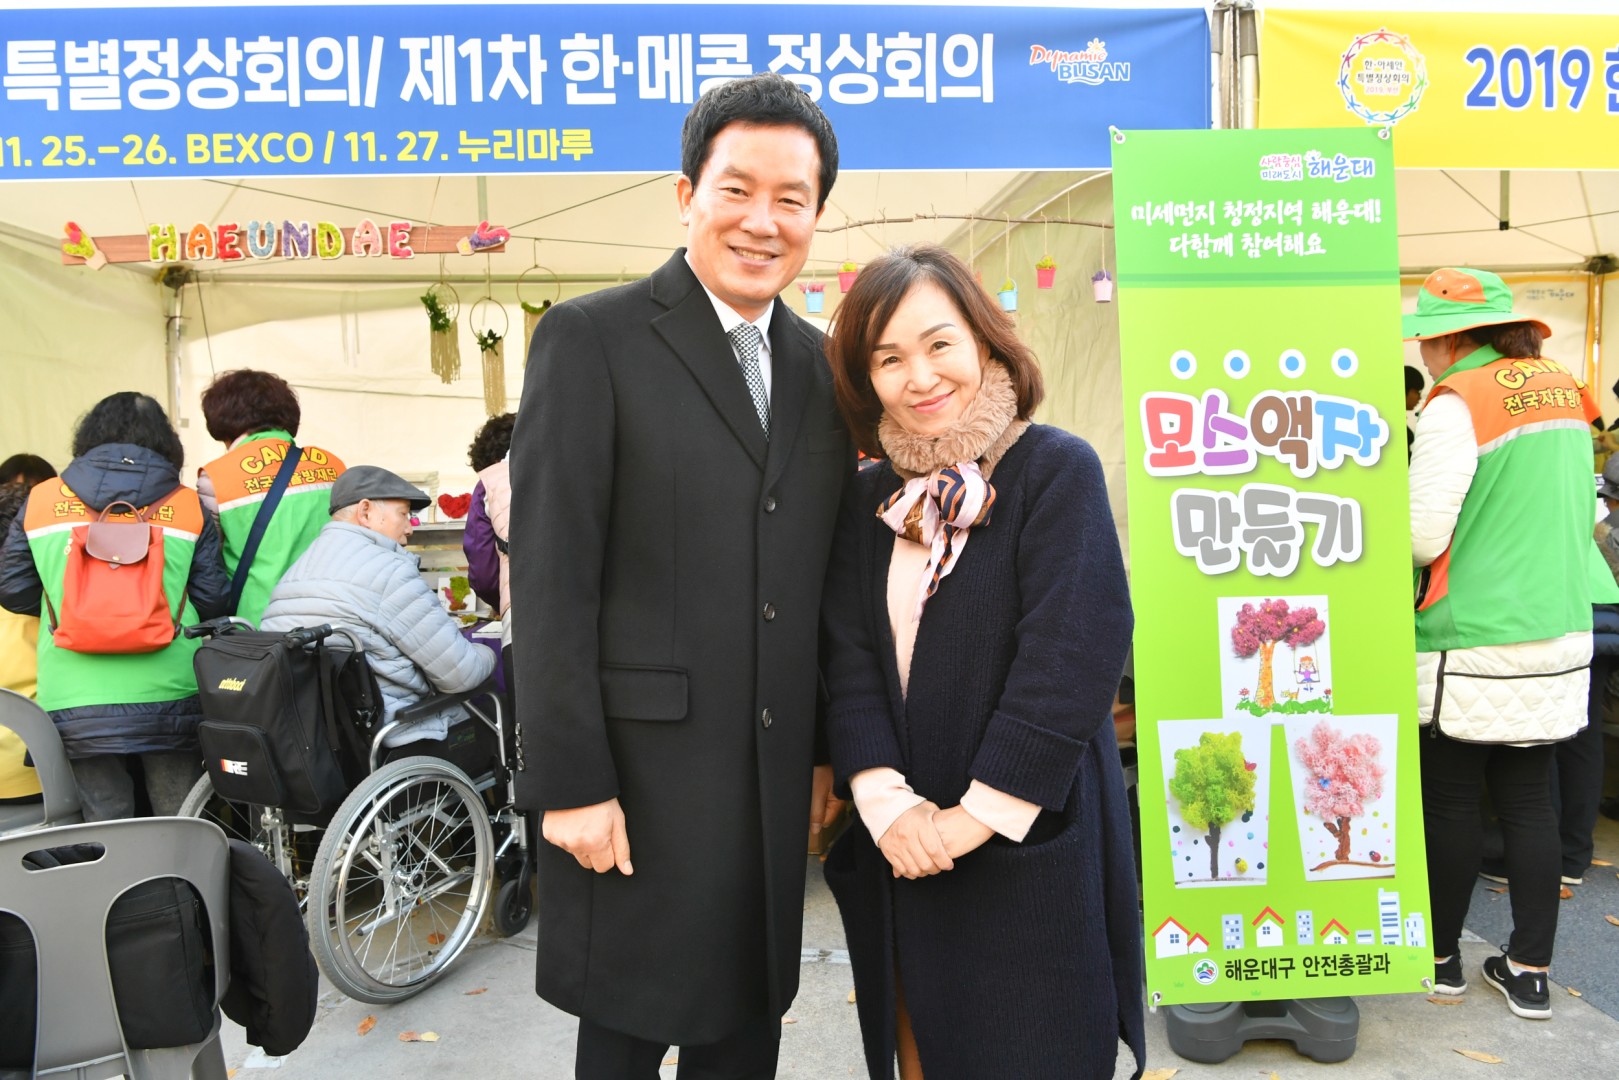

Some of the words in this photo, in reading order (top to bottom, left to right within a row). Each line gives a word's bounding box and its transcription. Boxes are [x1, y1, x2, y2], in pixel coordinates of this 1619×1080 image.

[3, 35, 383, 110] 특별정상회의/
[400, 34, 547, 106] 제1차
[767, 32, 994, 105] 정상회의
[1030, 45, 1107, 72] Dynamic
[1058, 62, 1130, 81] BUSAN
[1356, 72, 1410, 84] 특별정상회의
[1464, 47, 1592, 110] 2019
[187, 132, 313, 164] BEXCO
[344, 131, 387, 162] 11.
[397, 130, 448, 161] 27.
[458, 129, 593, 162] 누리마루
[1261, 155, 1301, 168] 사람중심
[1308, 155, 1373, 181] 해운대
[1261, 169, 1302, 180] 미래도시
[1131, 200, 1215, 226] 미세먼지
[1223, 199, 1303, 227] 청정지역
[1312, 198, 1382, 225] 해운대!
[148, 218, 414, 261] HAEUNDAE
[1169, 233, 1234, 259] 다함께
[1241, 231, 1327, 257] 참여해요
[1141, 390, 1390, 477] 모스액자
[244, 467, 337, 494] 전국율방재단
[1224, 958, 1296, 981] 해운대구
[1302, 952, 1391, 978] 안전총괄과
